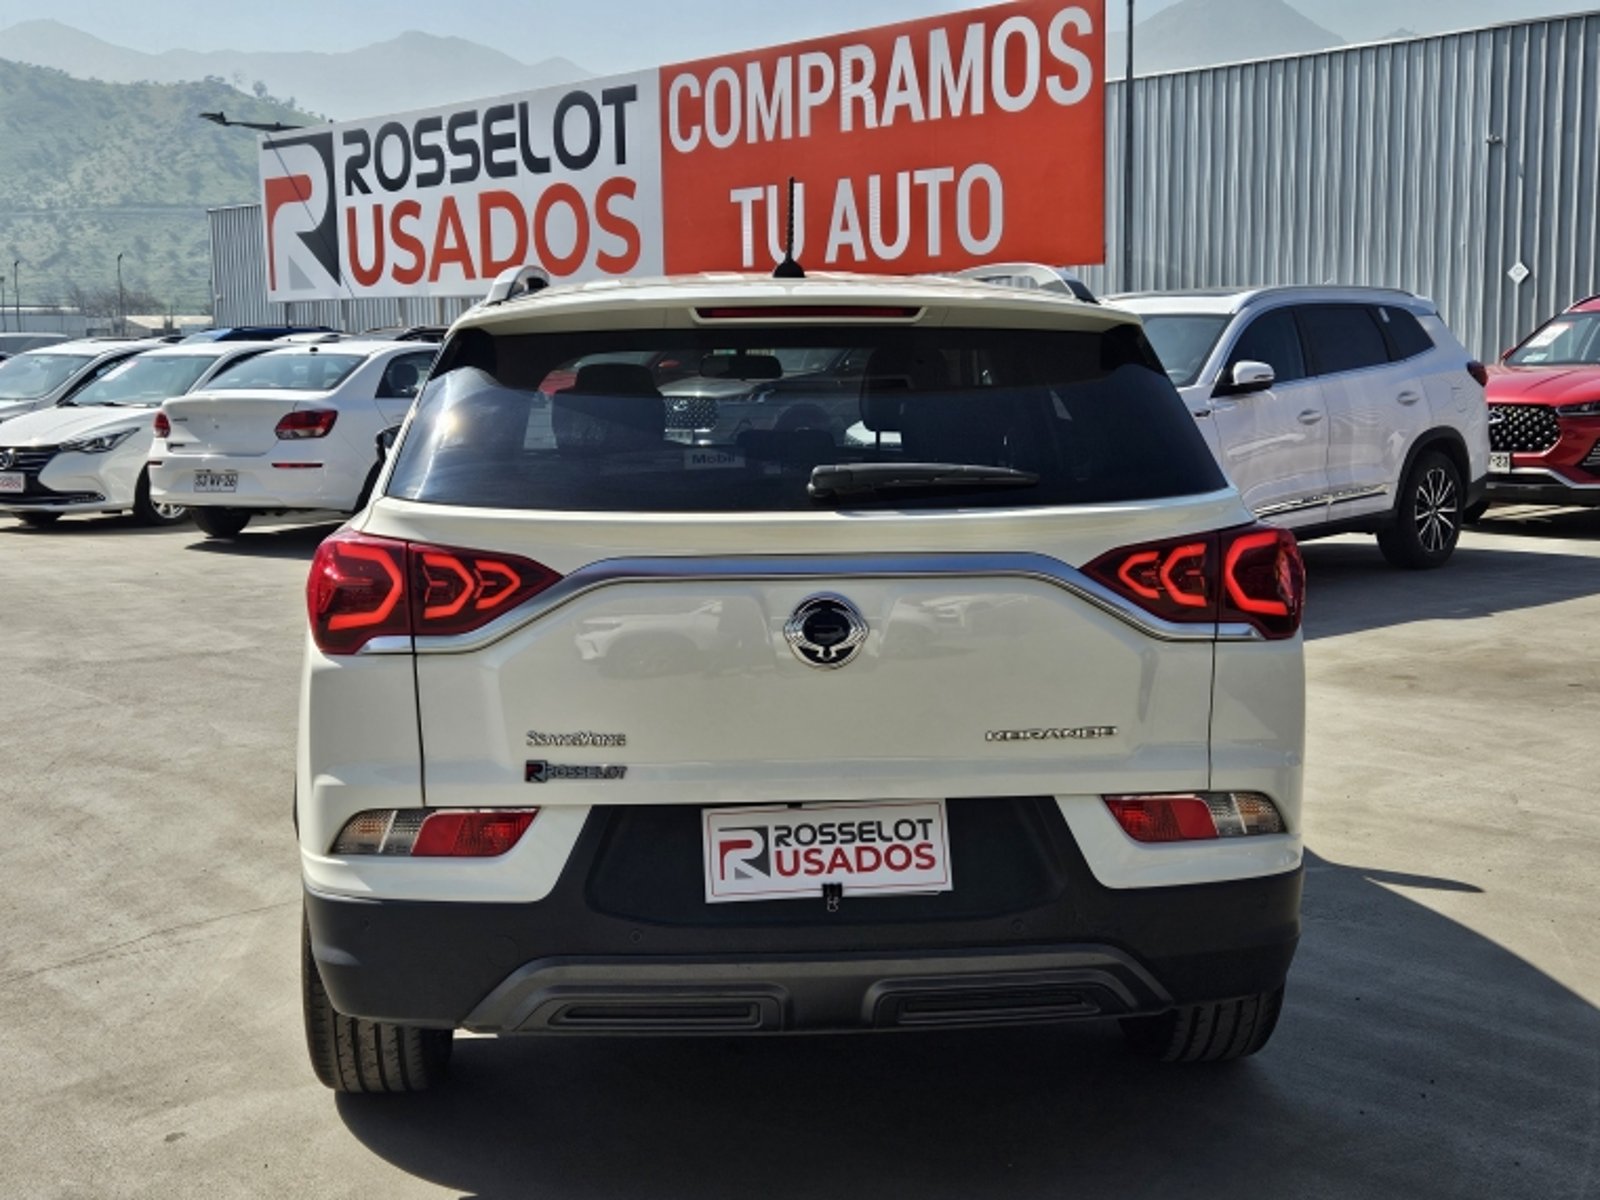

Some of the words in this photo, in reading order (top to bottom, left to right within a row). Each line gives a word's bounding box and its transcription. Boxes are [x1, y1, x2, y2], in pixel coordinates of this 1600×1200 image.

[668, 6, 1094, 153] COMPRAMOS
[342, 84, 637, 196] ROSSELOT
[345, 176, 641, 287] USADOS
[730, 182, 805, 268] TU
[824, 163, 1005, 264] AUTO
[546, 764, 627, 779] ROSSELOT
[774, 819, 933, 847] ROSSELOT
[775, 843, 936, 877] USADOS
